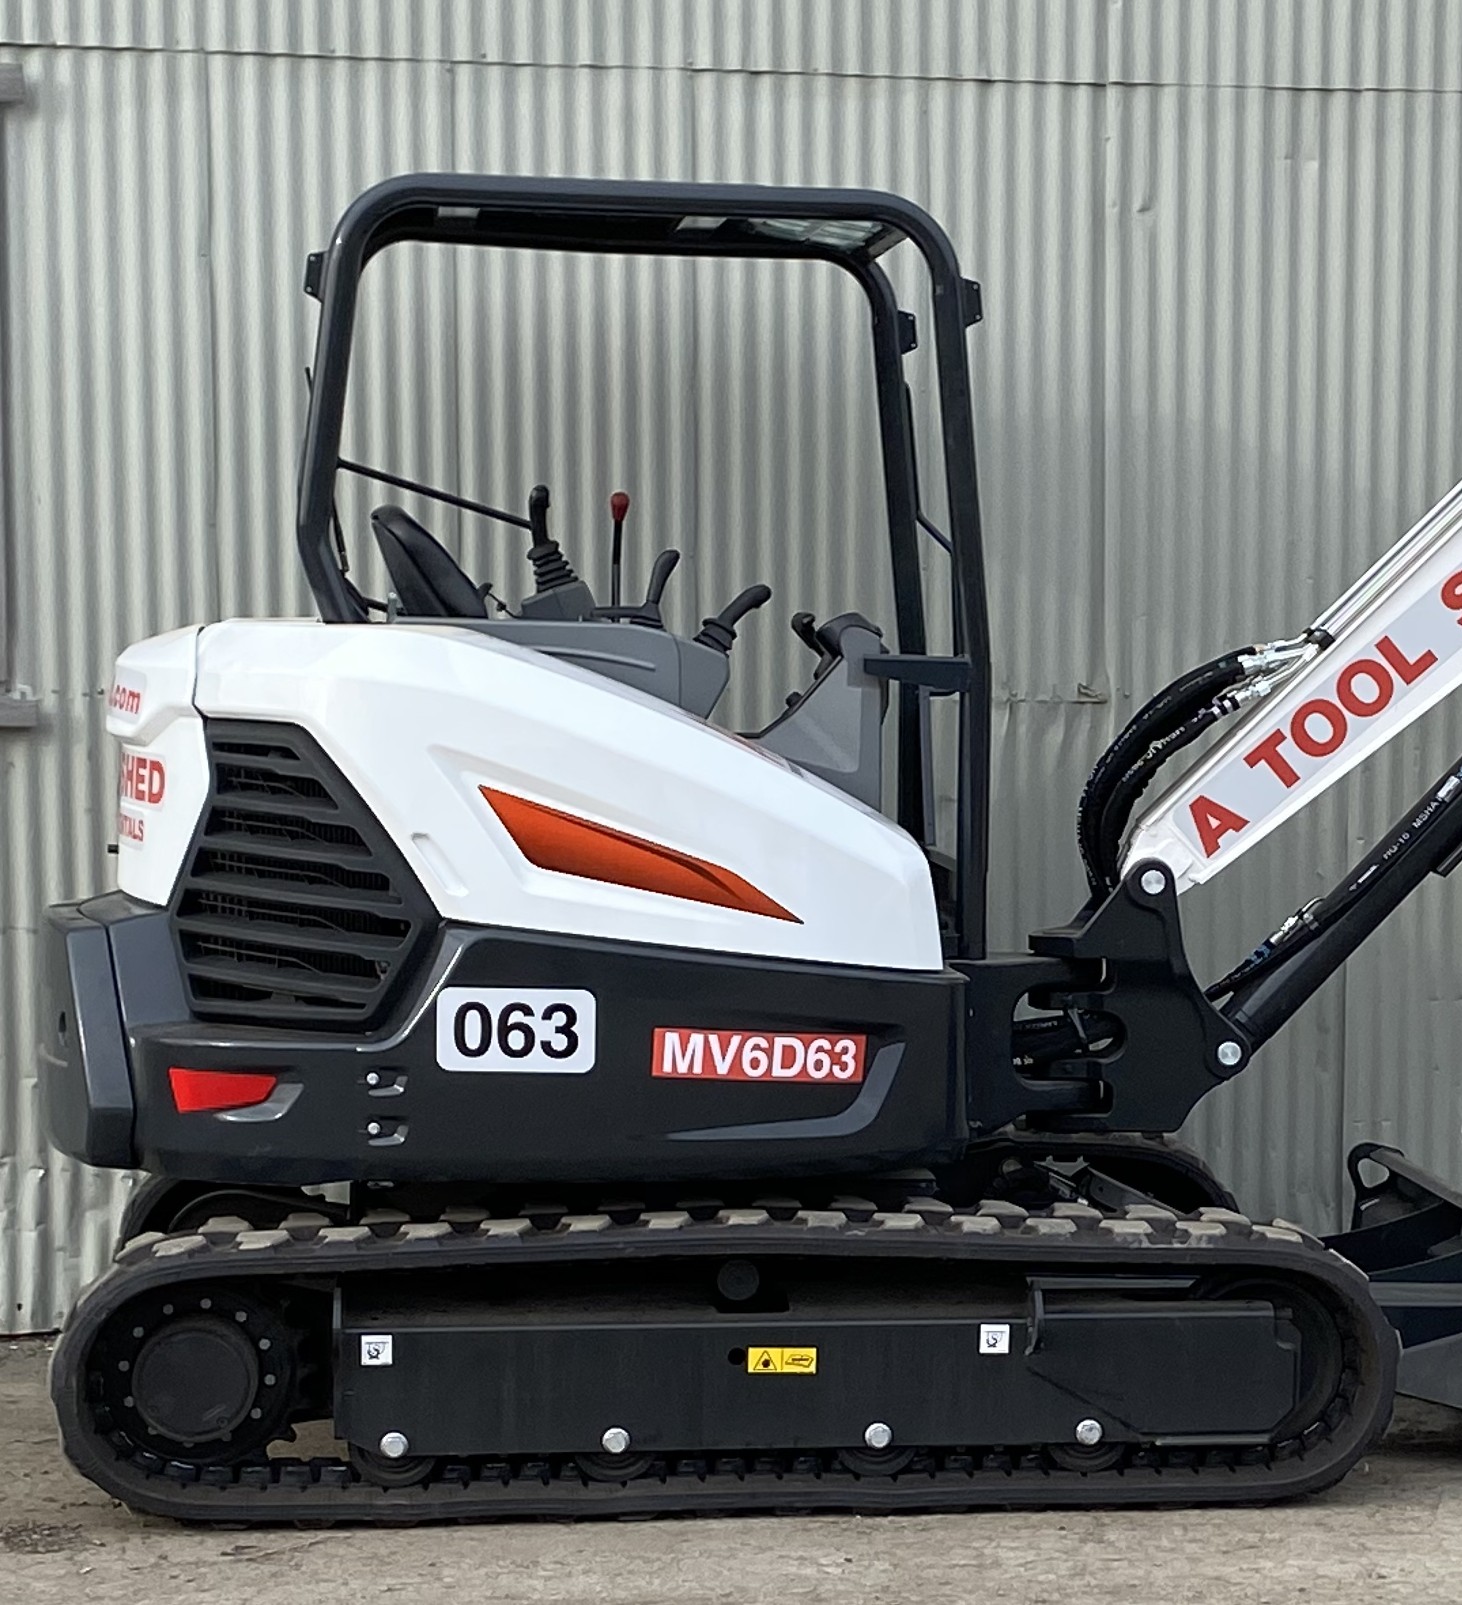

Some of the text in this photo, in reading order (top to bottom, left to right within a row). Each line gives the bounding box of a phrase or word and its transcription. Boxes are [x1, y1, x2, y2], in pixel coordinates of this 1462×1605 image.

[1189, 794, 1251, 859] A
[1242, 635, 1439, 789] TOOL
[453, 1001, 580, 1060] 063
[661, 1031, 858, 1080] MV6D63
